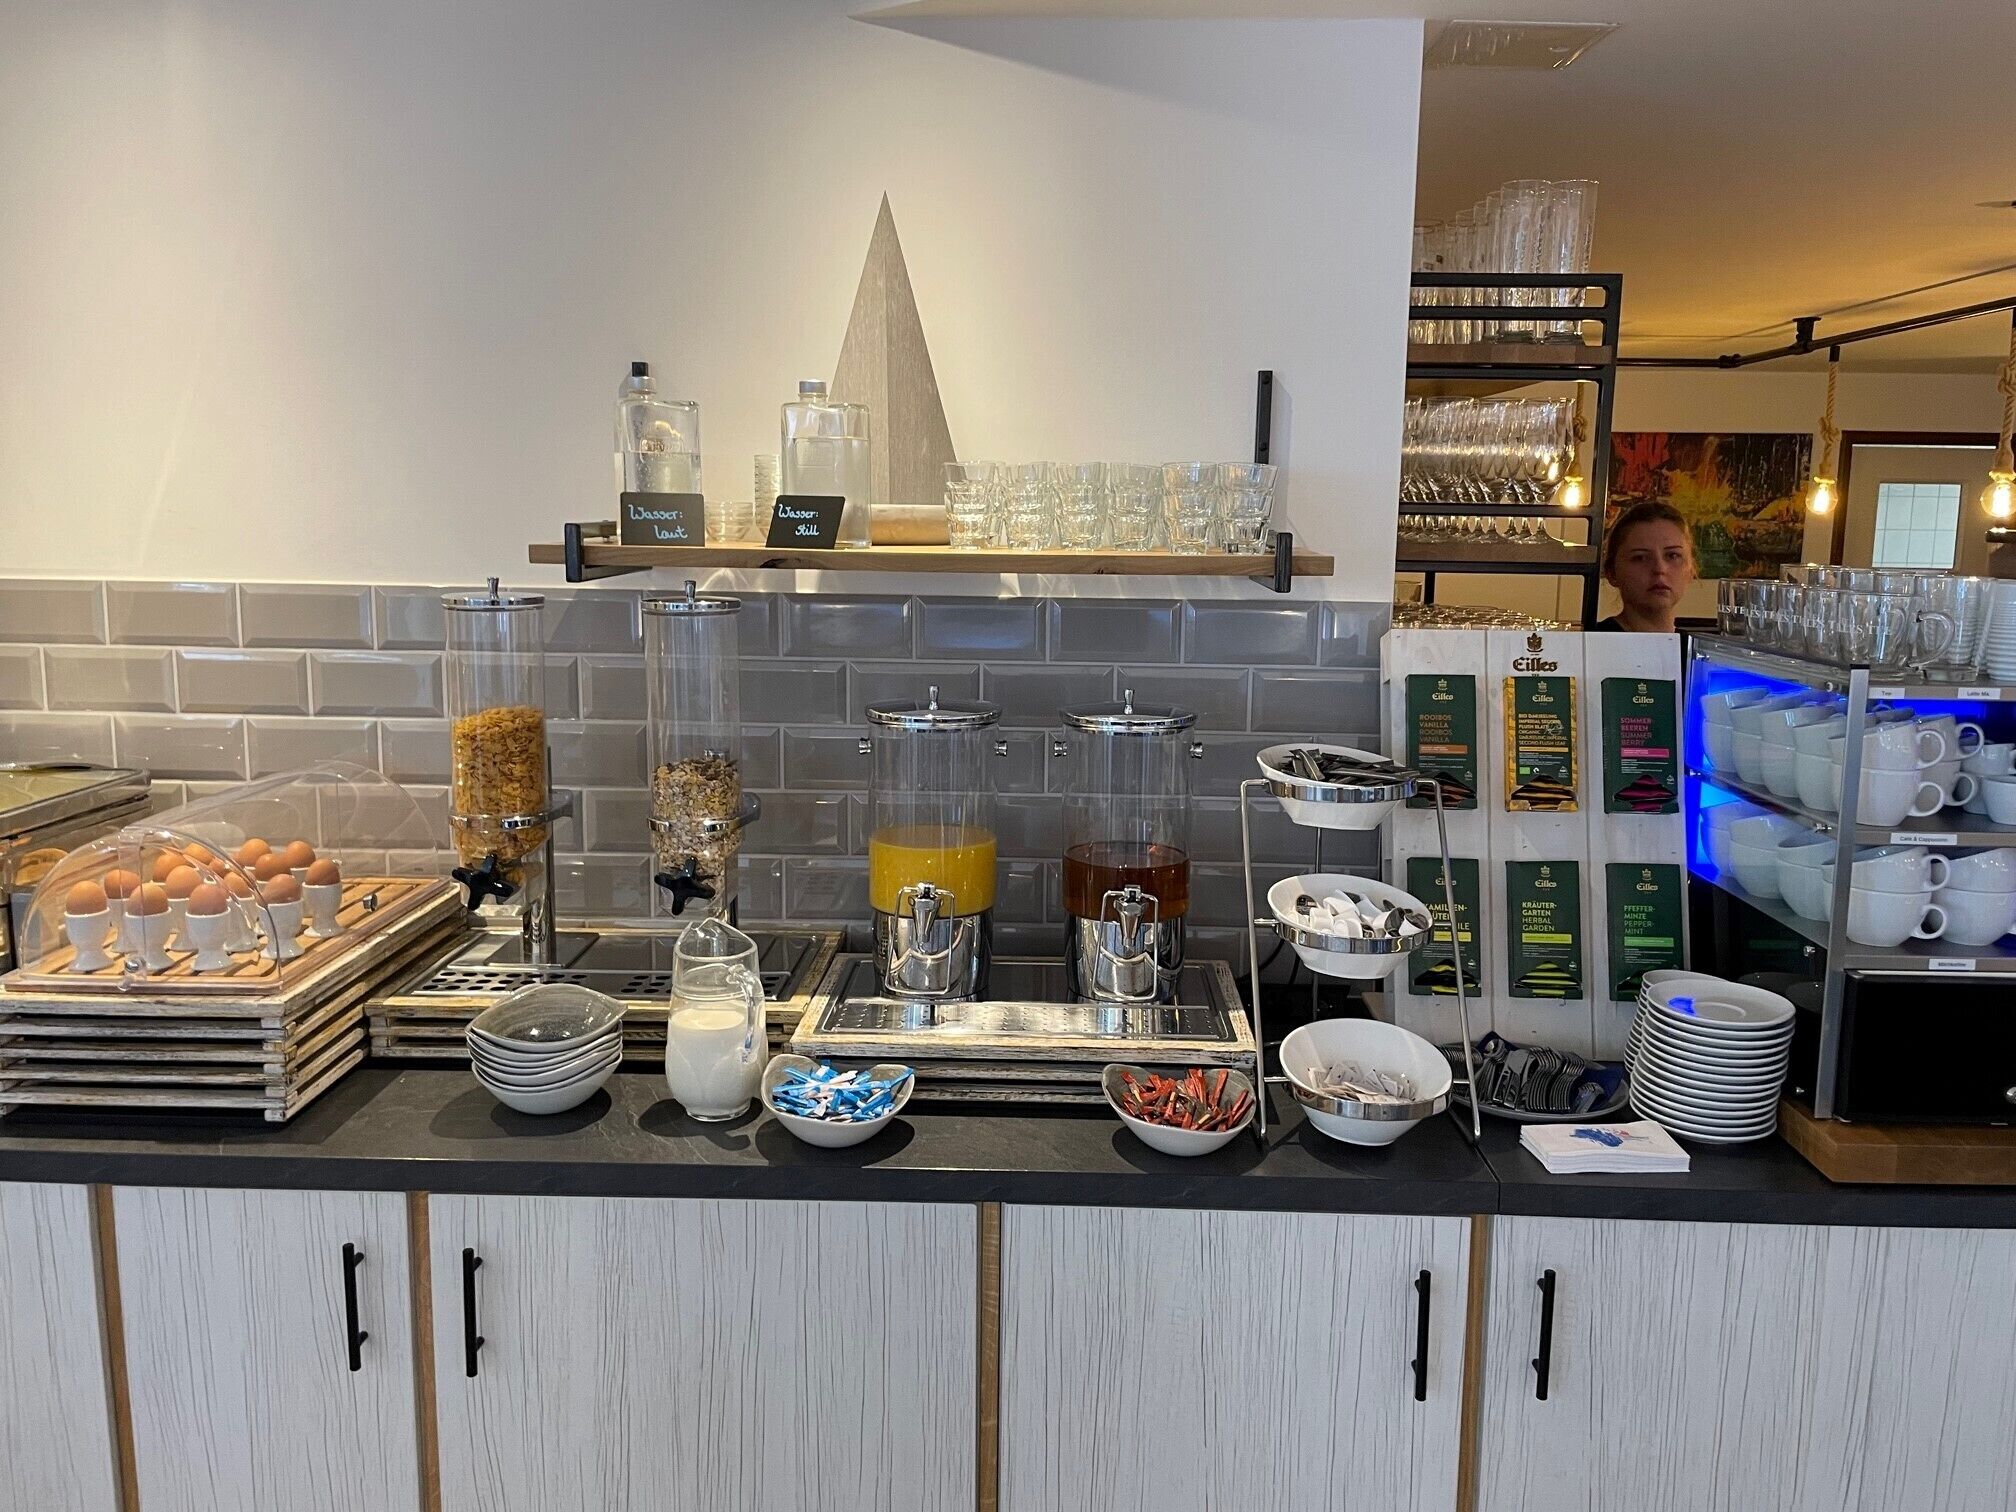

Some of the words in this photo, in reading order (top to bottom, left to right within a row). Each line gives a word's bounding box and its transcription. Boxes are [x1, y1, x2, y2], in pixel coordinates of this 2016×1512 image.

[628, 504, 683, 521] Wasser:
[778, 504, 819, 519] Wasser:
[655, 525, 688, 540] laut
[1513, 657, 1558, 672] Eilles
[1621, 739, 1646, 747] BERRY
[1425, 903, 1468, 912] AMILEN-
[1522, 900, 1557, 909] KRÄUTER-
[1522, 909, 1551, 917] GARTEN
[1522, 924, 1555, 932] GARDEN
[1624, 920, 1655, 928] PEPPER-
